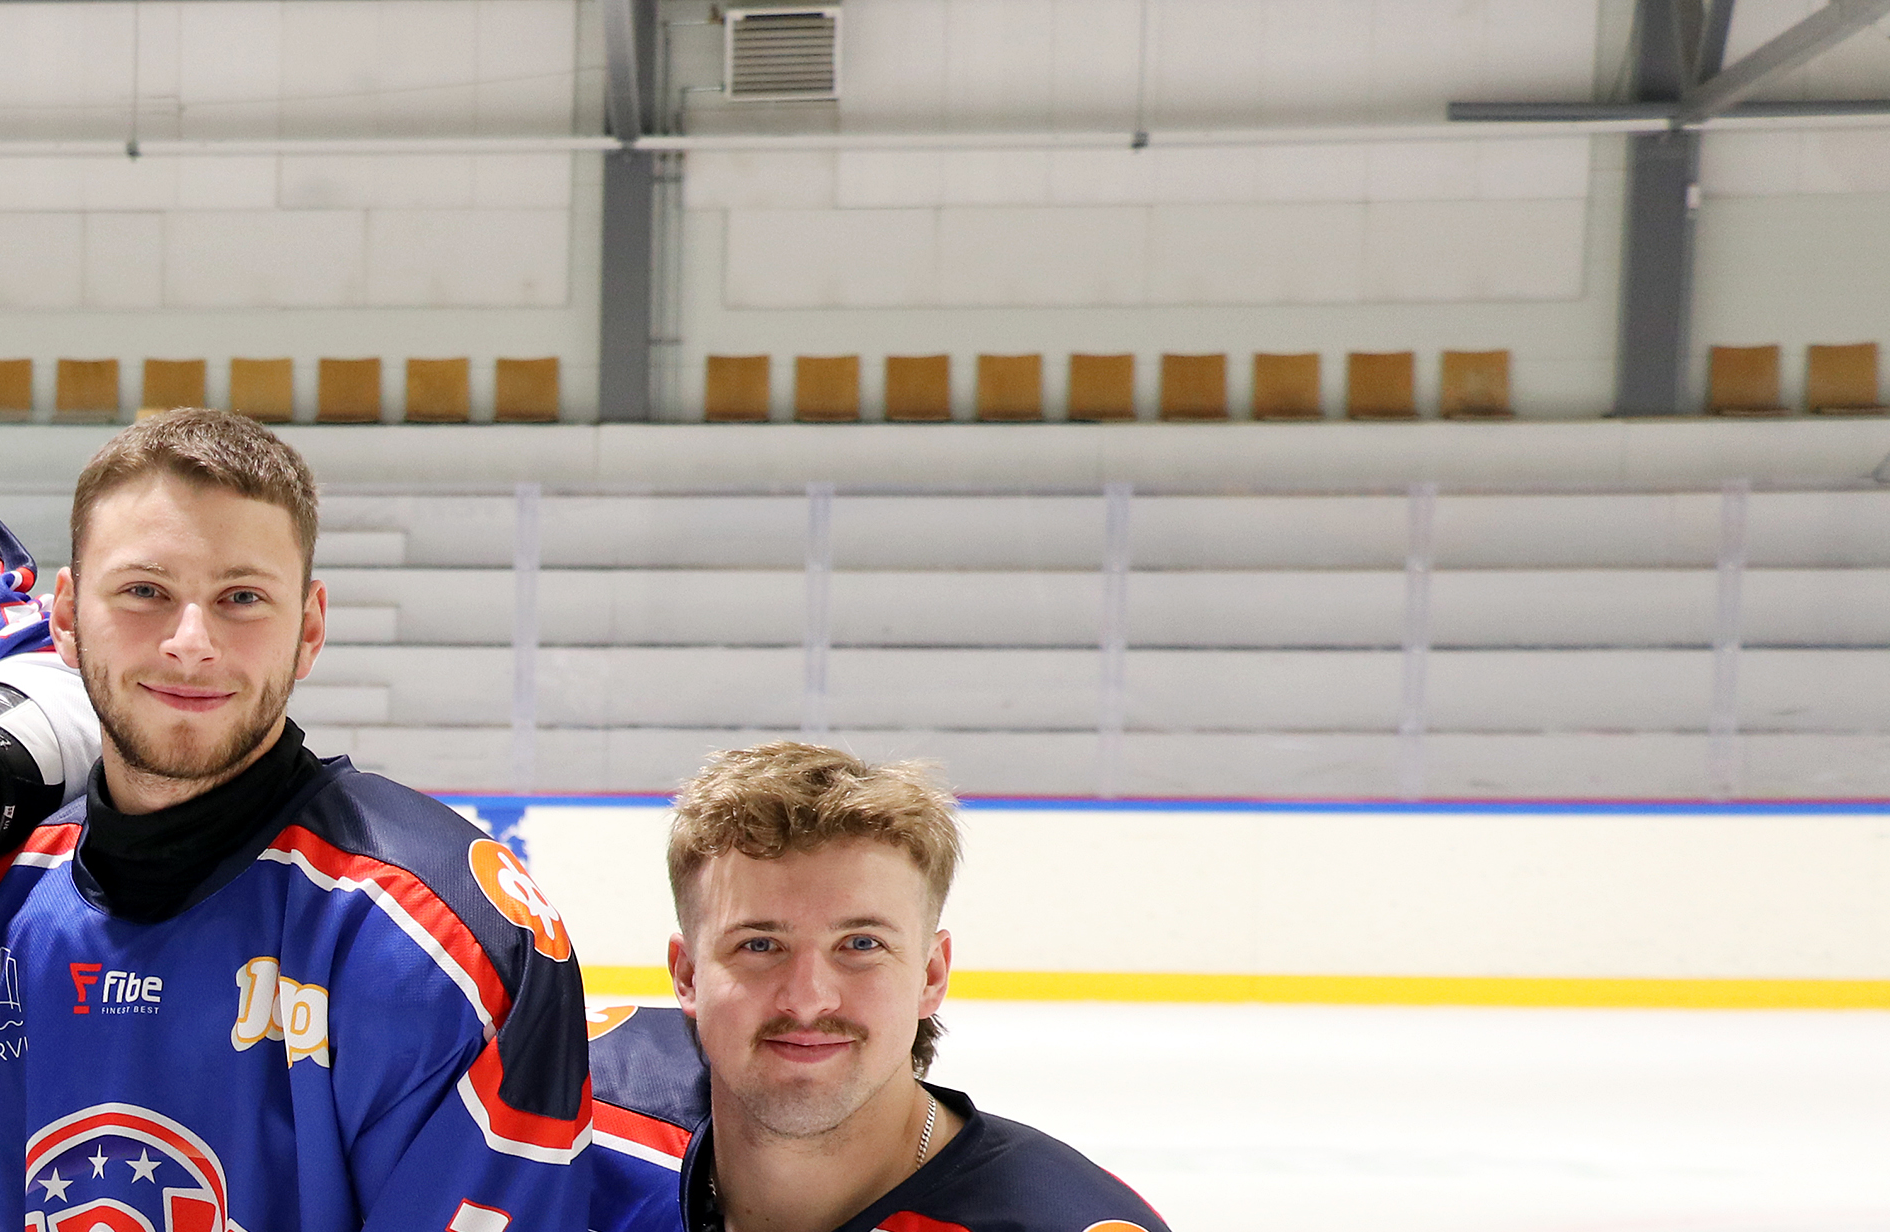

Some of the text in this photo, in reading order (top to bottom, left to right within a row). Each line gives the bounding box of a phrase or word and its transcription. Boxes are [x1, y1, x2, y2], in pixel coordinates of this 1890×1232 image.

[102, 970, 164, 1003] Fibe
[101, 1005, 160, 1015] FINEST BEST
